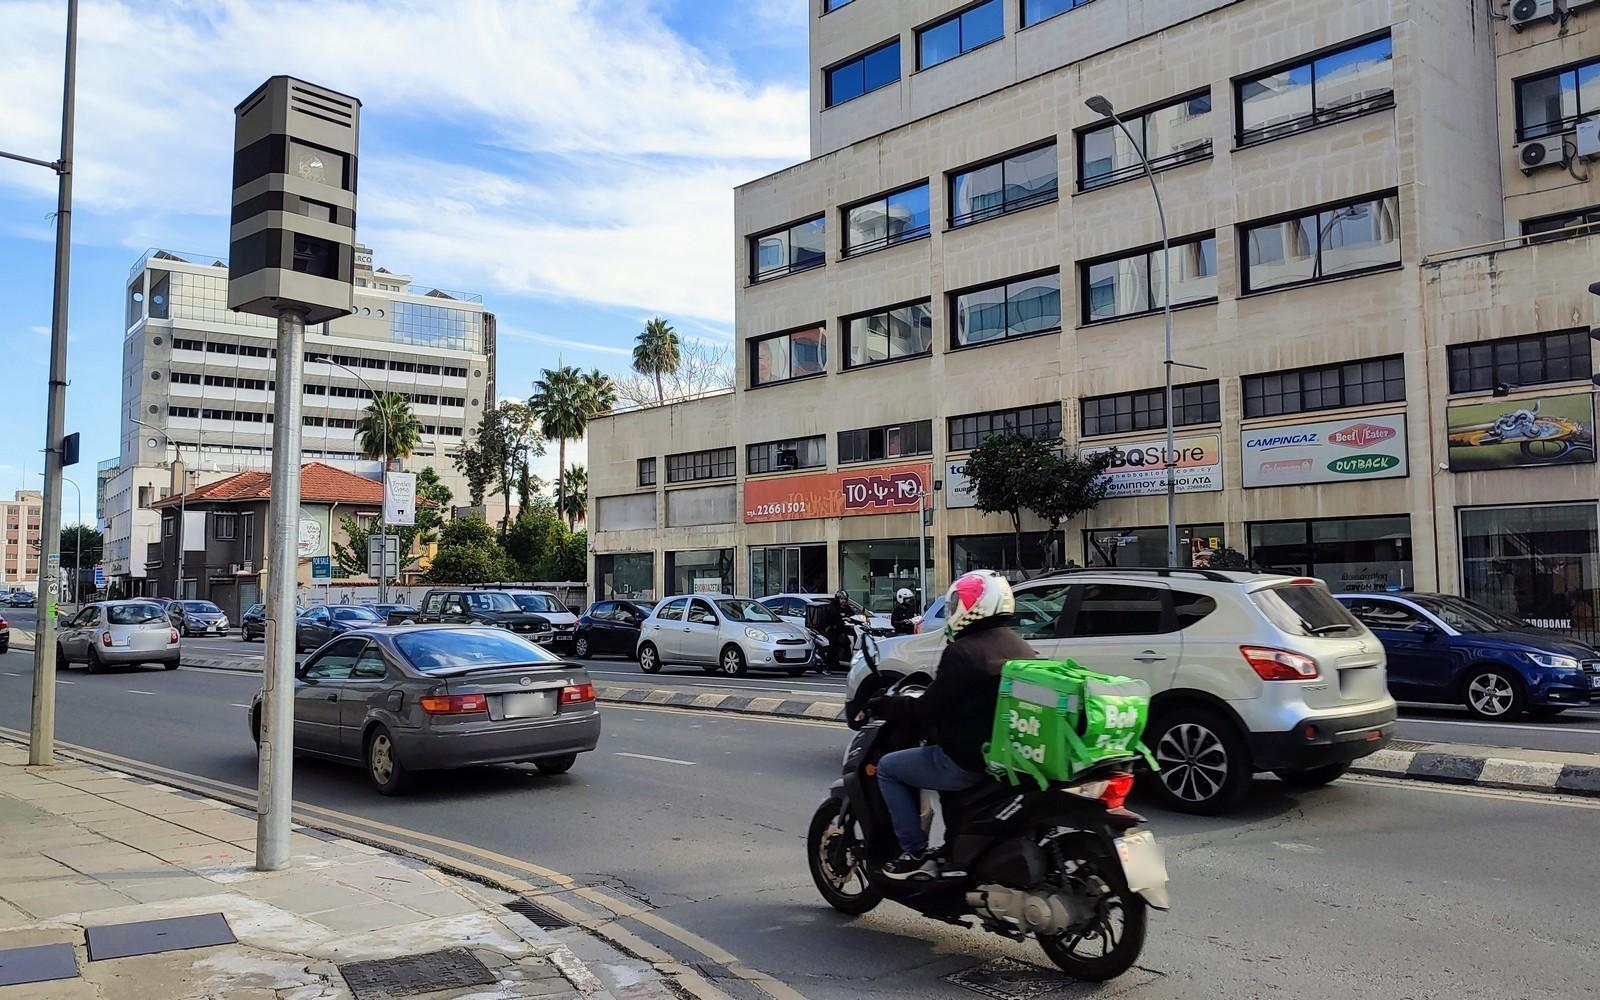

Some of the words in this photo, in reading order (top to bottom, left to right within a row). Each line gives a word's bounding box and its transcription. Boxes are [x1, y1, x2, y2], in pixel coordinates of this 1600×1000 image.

[1246, 433, 1317, 448] CAMPINGAZ
[1336, 457, 1389, 471] OUTBACK
[1108, 480, 1156, 491] ΦΙΛΙΠΠΟΥ
[1192, 476, 1212, 484] ΛΤΔ
[1104, 704, 1139, 729] Bolt
[1012, 741, 1045, 764] ood
